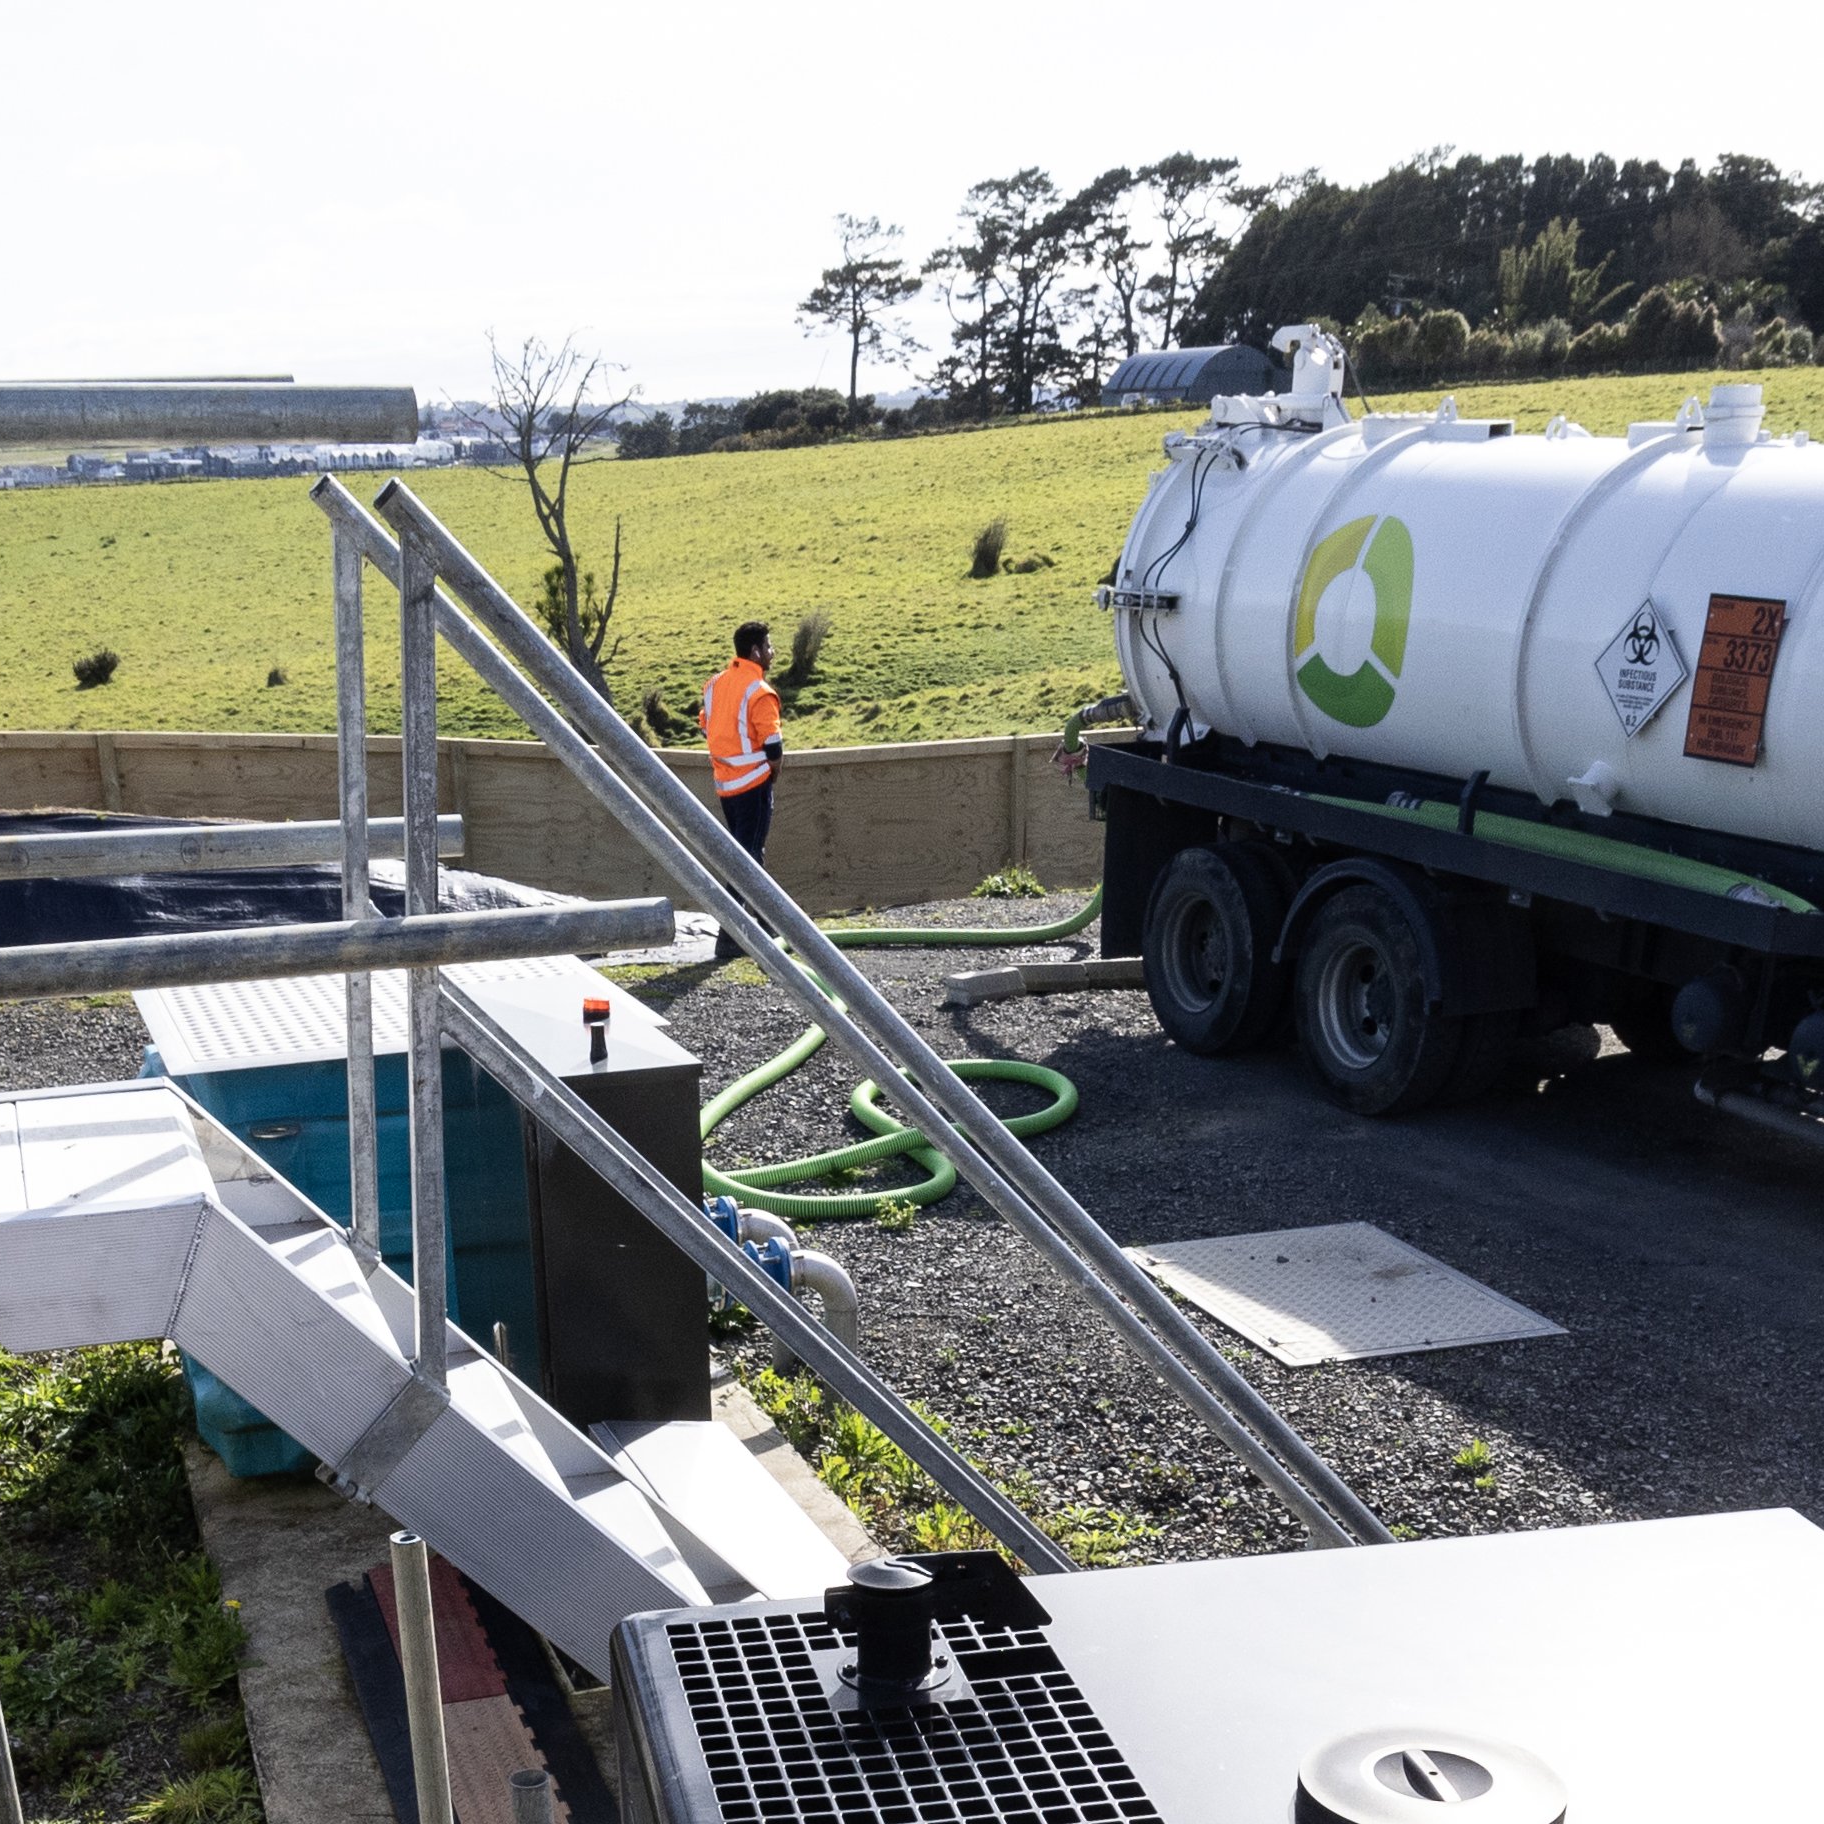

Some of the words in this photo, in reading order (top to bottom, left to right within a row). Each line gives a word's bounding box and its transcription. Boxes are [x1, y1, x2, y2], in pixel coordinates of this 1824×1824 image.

[1751, 606, 1780, 637] 2X
[1723, 639, 1773, 673] 3373
[1618, 679, 1655, 693] SUBSTANCE
[1619, 668, 1657, 682] INFECTIOUS
